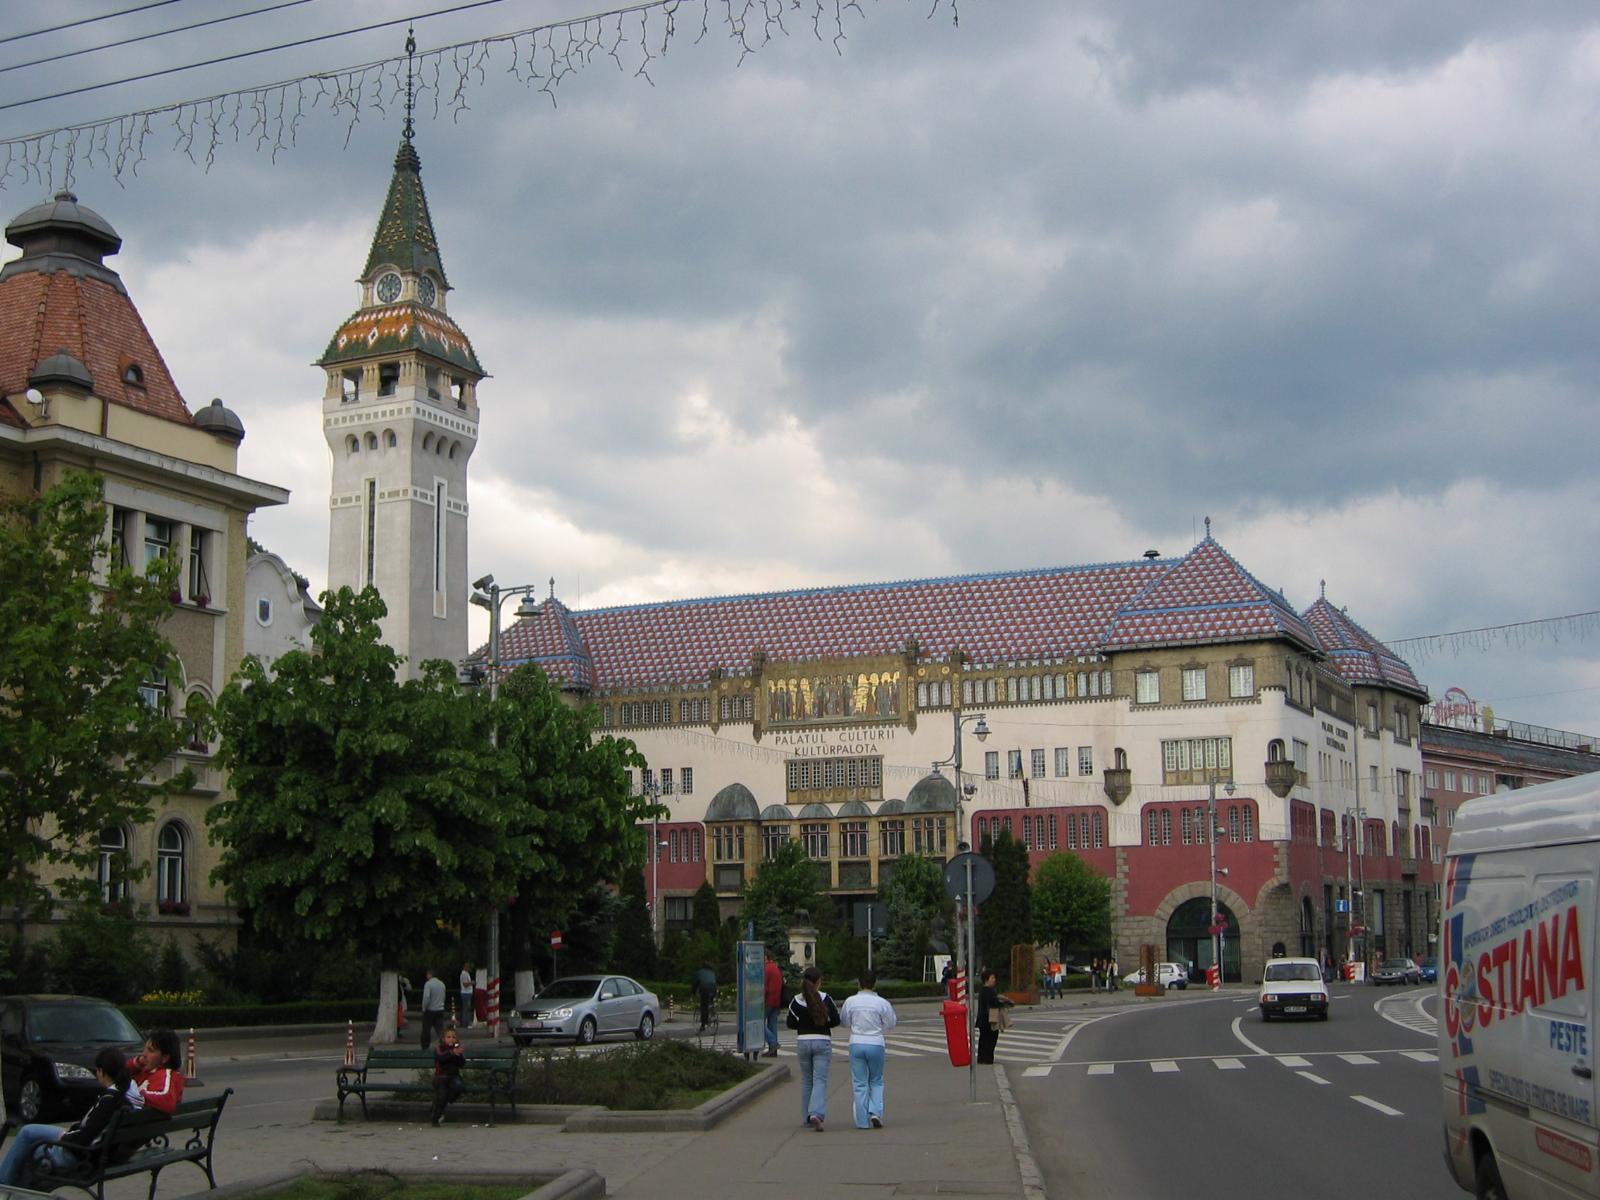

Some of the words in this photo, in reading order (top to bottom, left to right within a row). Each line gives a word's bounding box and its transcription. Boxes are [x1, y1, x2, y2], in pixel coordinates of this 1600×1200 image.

[775, 733, 827, 746] PALATUL
[839, 729, 895, 742] CULTURII
[1550, 1020, 1588, 1056] PESTE
